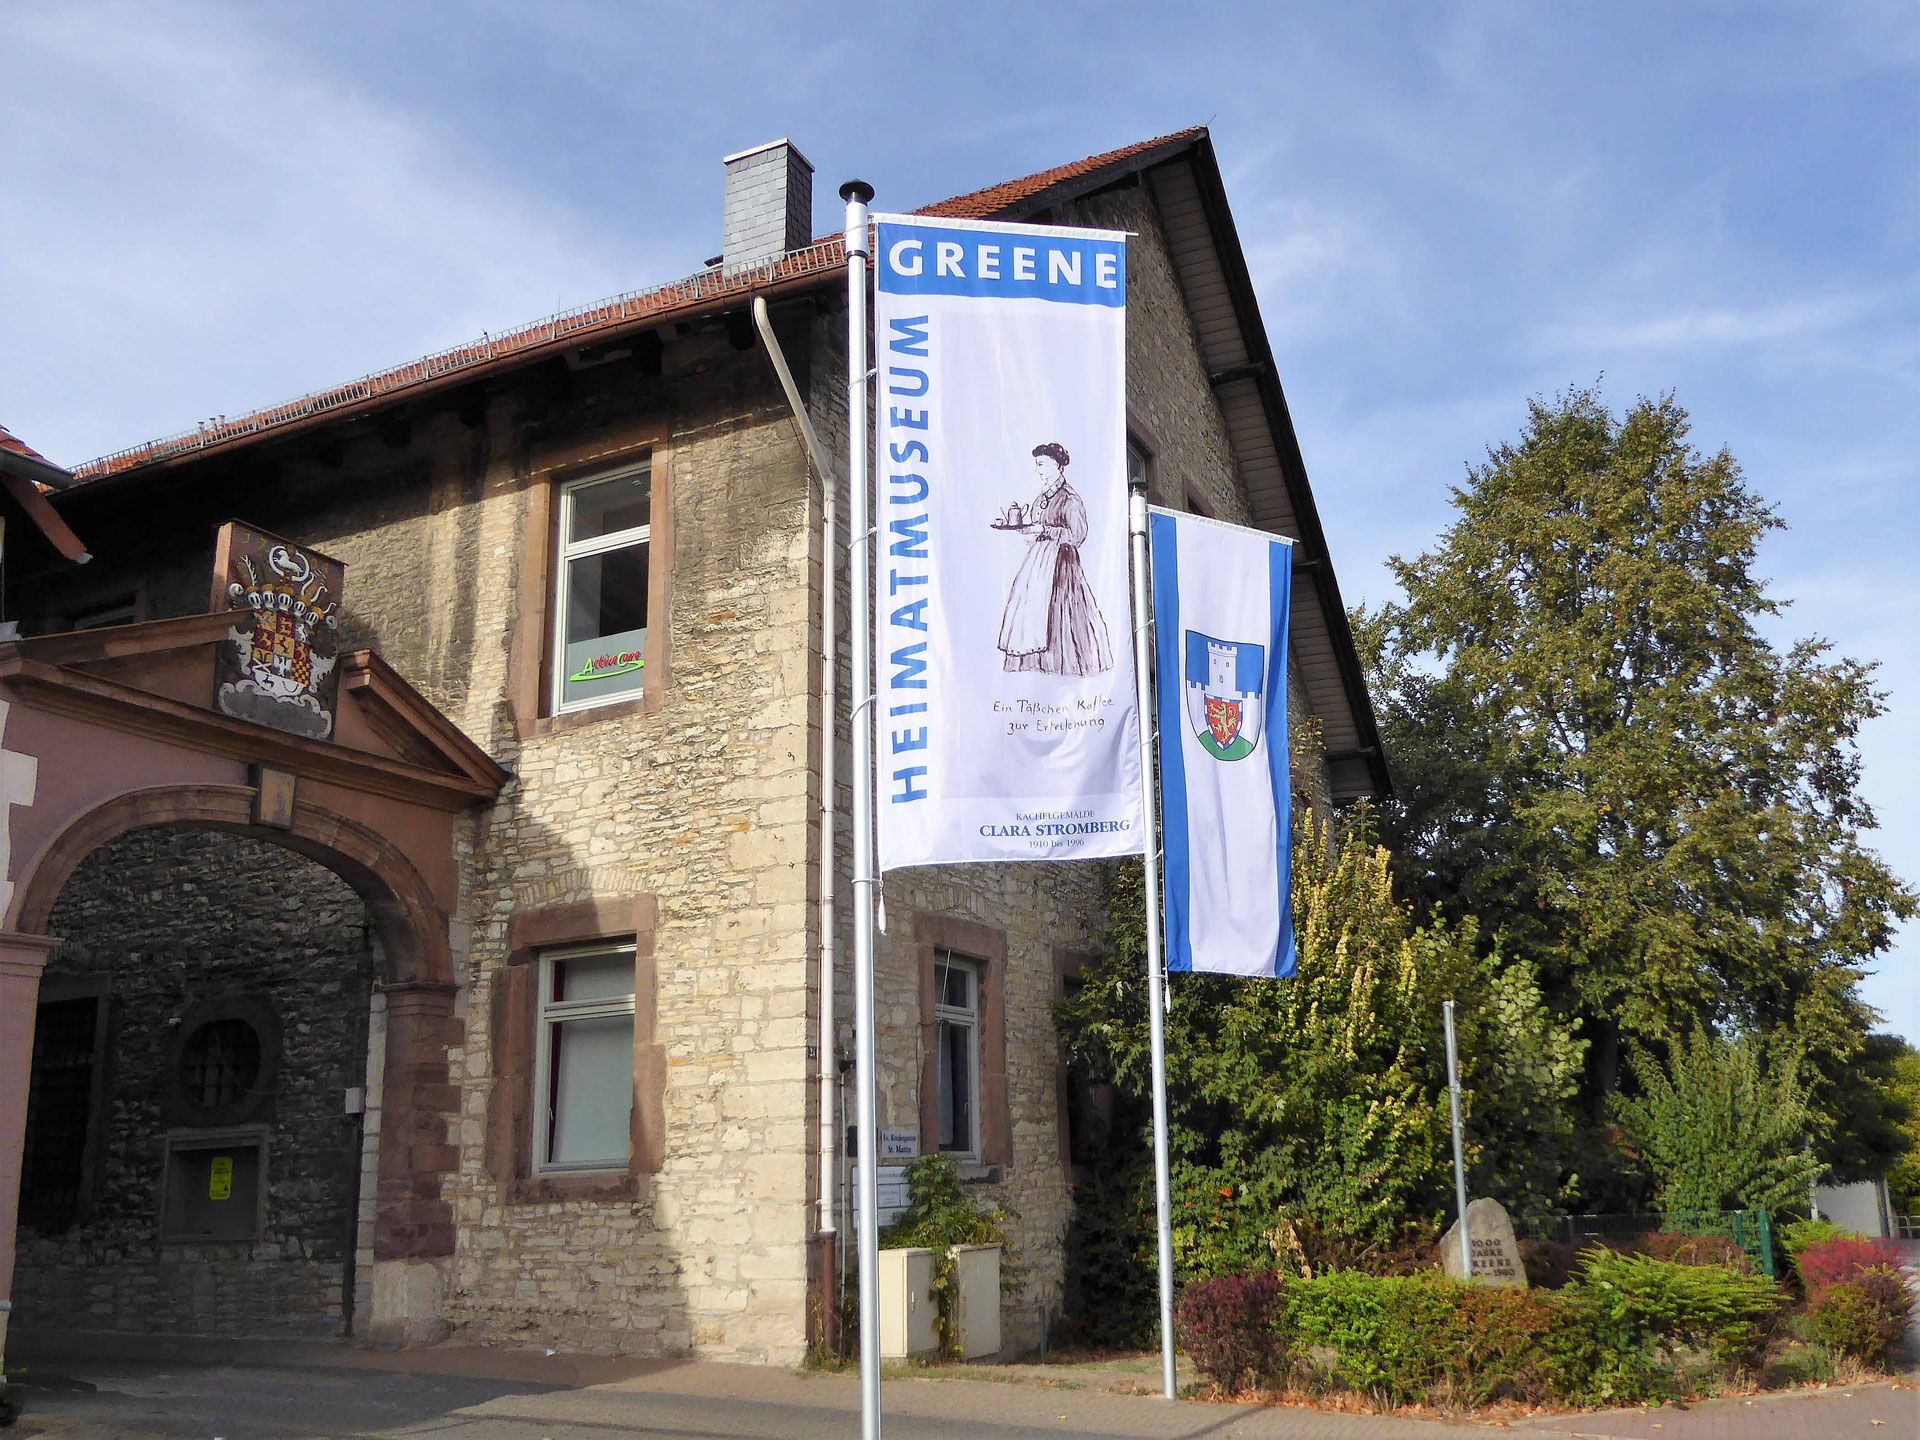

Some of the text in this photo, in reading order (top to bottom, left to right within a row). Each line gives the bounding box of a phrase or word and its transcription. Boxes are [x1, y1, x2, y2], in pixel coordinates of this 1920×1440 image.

[888, 239, 1117, 289] GREENE
[889, 315, 930, 804] HEIMATMUSEUM
[993, 700, 1012, 712] Ein
[979, 819, 1130, 837] CLARA STROMBERG
[1029, 840, 1049, 849] 1910
[1066, 838, 1085, 847] 1996
